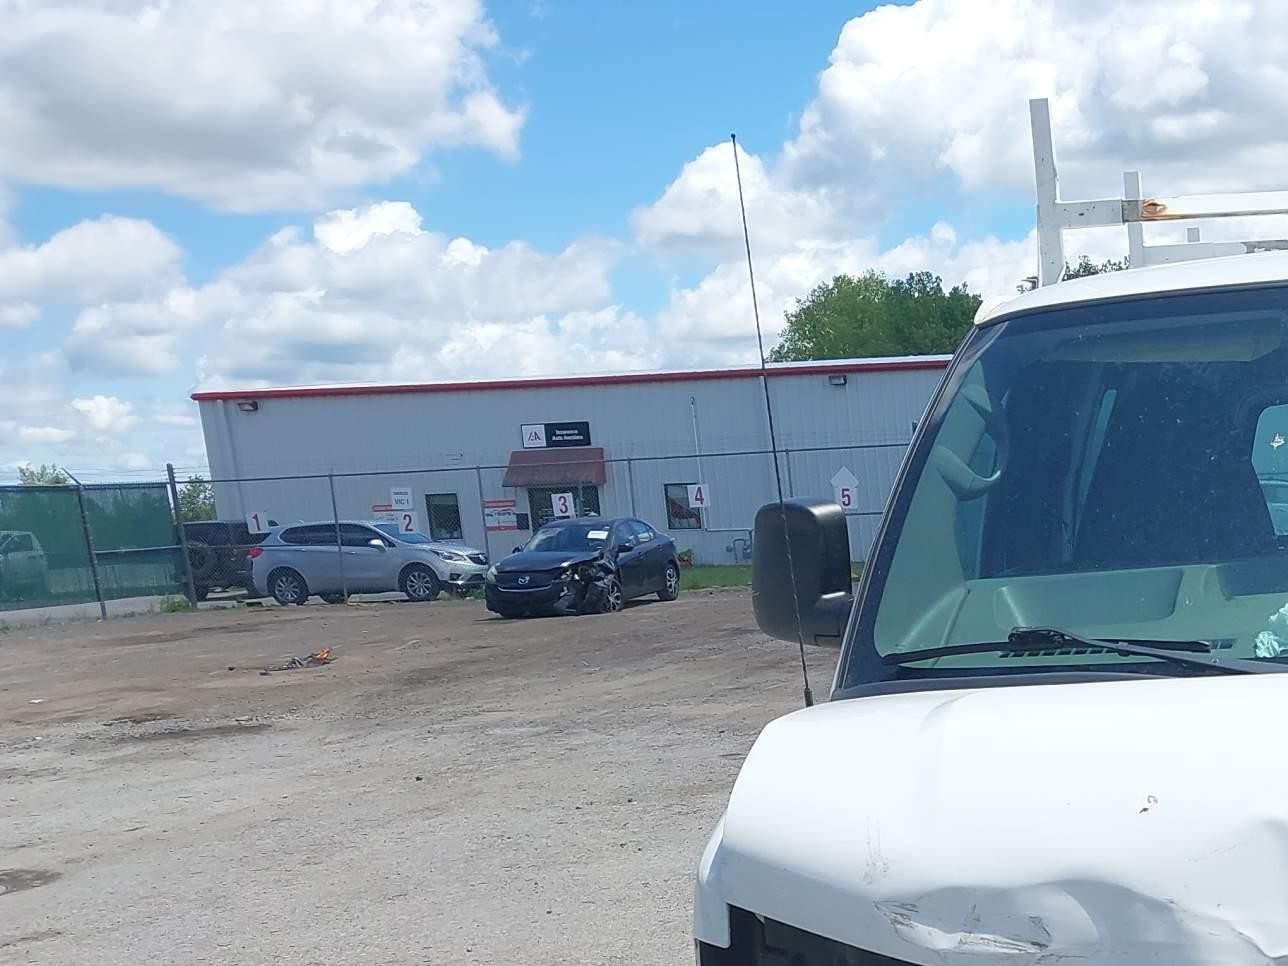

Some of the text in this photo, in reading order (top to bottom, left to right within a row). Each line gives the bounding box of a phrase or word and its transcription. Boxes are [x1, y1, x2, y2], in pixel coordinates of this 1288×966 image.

[558, 495, 569, 514] 3
[694, 486, 704, 505] 4
[841, 488, 851, 506] 5
[252, 513, 261, 531] 1
[403, 513, 413, 531] 2
